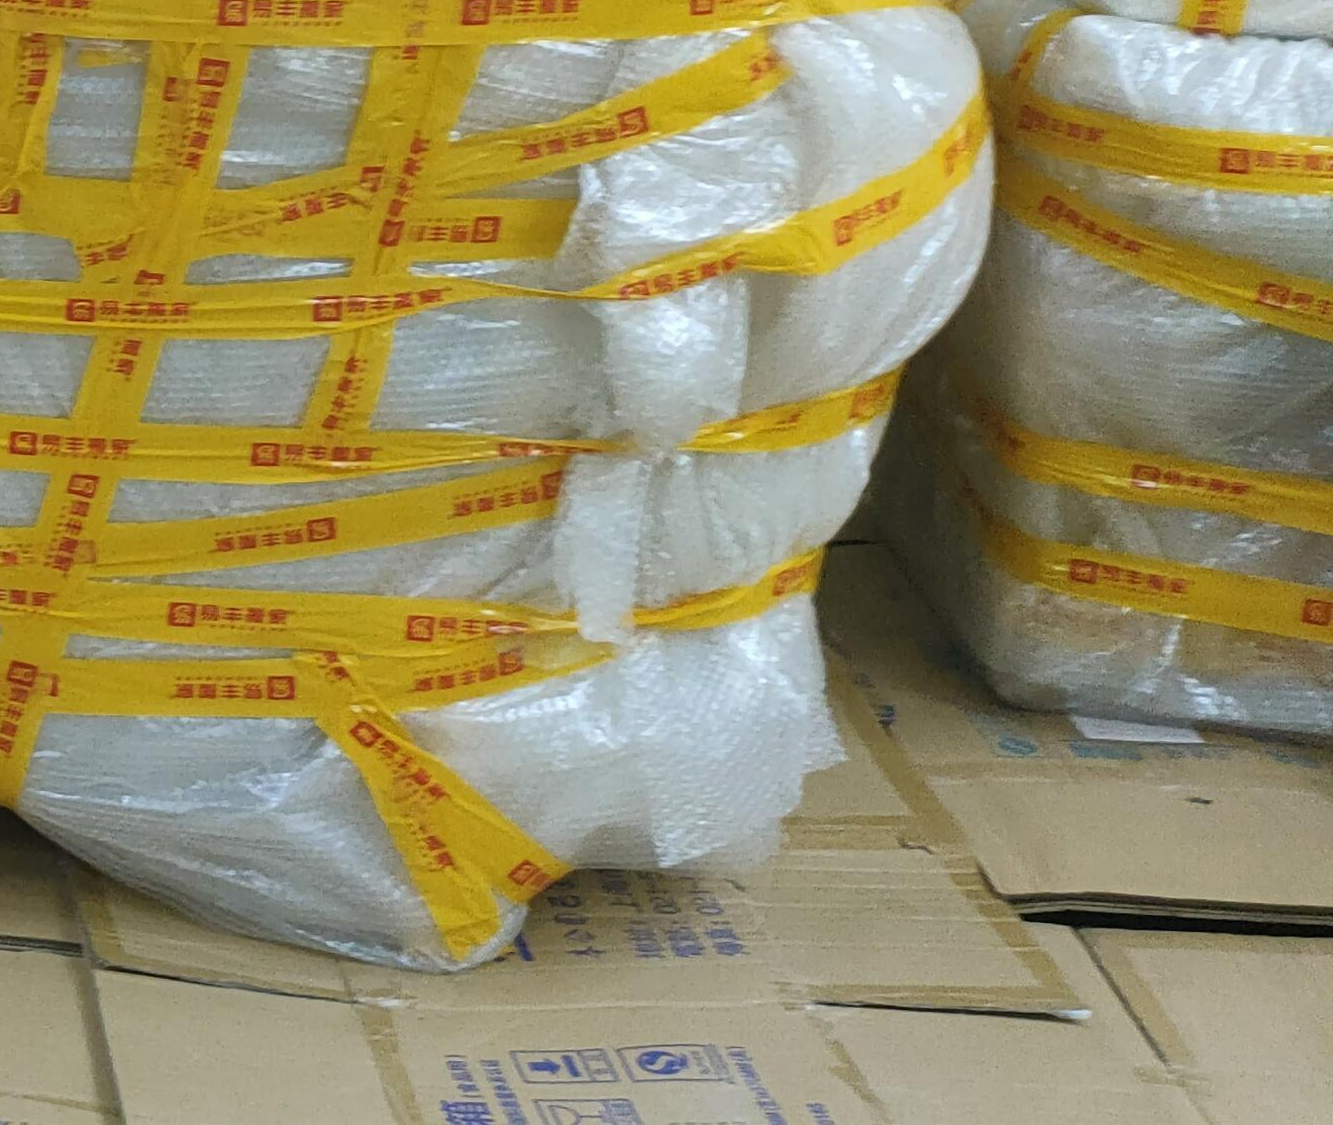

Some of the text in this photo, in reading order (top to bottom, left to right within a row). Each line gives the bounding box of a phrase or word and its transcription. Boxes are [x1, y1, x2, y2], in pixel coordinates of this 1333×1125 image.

[252, 0, 345, 19] 易丰搬家
[41, 434, 135, 455] 易丰搬家
